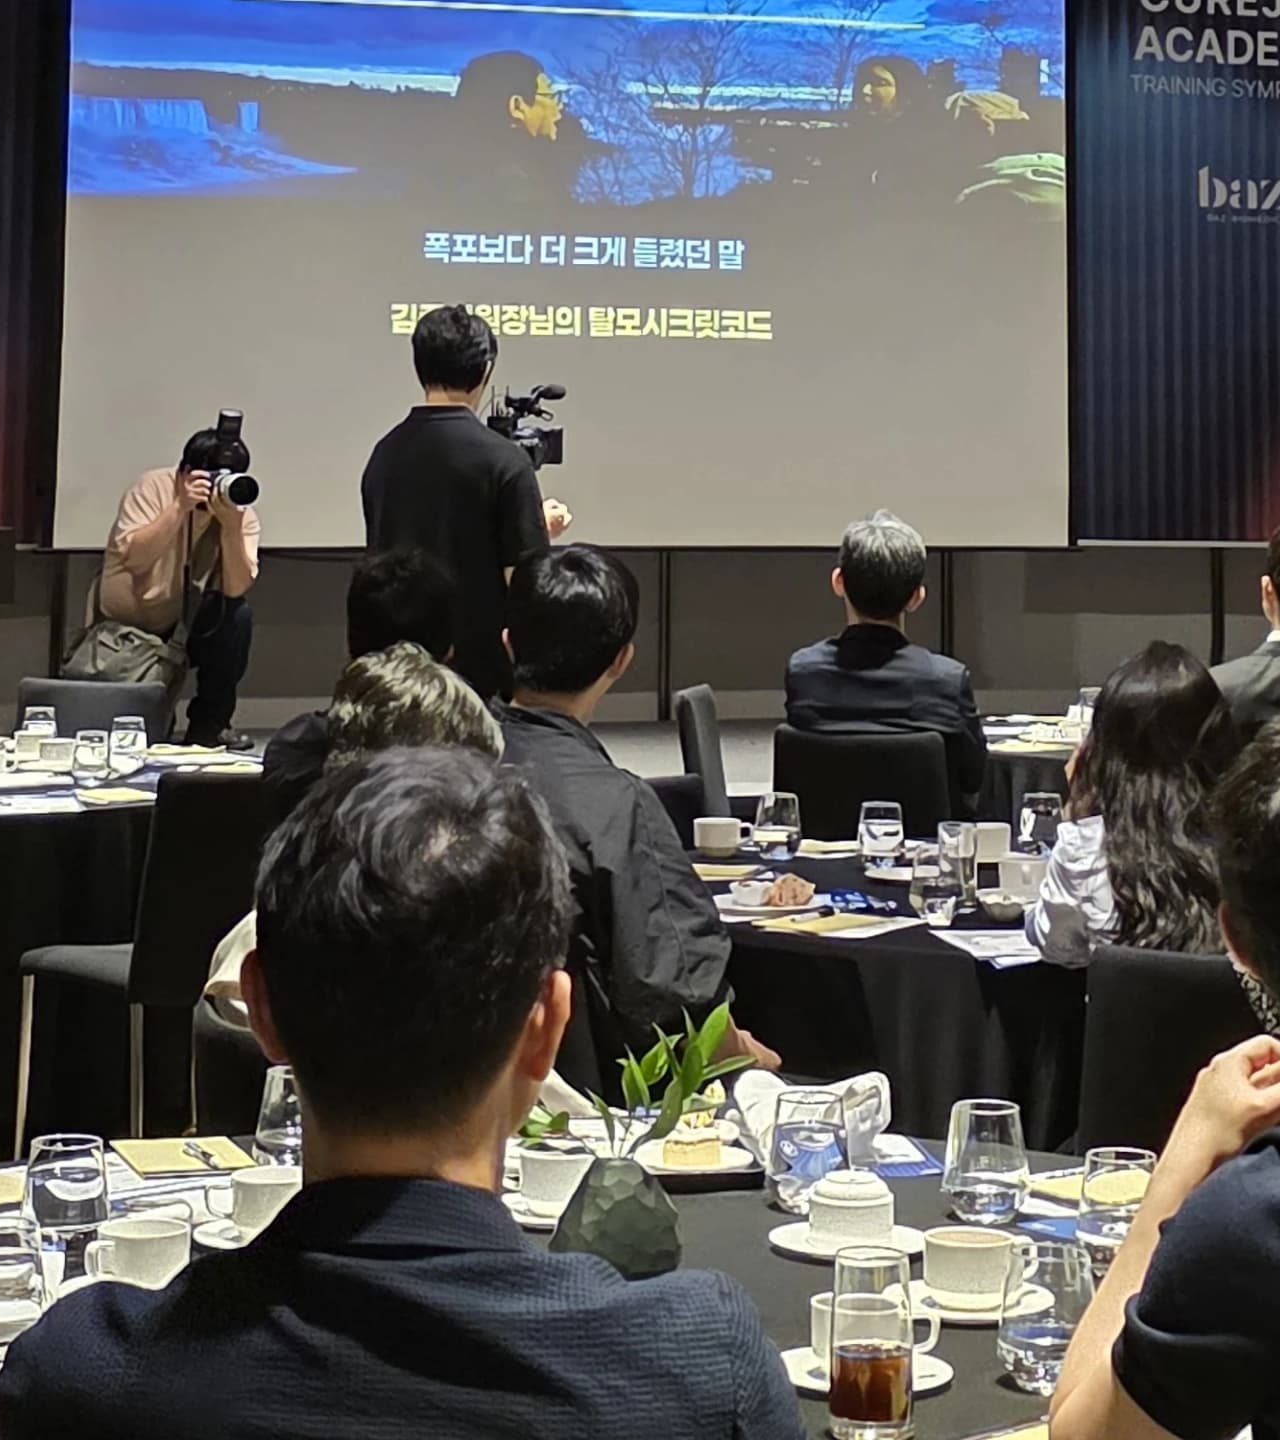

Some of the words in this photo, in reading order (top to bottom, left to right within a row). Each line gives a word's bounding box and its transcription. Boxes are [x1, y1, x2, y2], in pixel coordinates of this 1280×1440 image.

[1130, 74, 1226, 98] TRAINING
[423, 232, 533, 264] 폭포보다
[540, 235, 567, 266] 더
[572, 236, 627, 267] 크게
[633, 237, 712, 270] 들렸던
[717, 239, 745, 271] 말
[390, 303, 582, 337] 김원장님의
[588, 306, 774, 341] 탈모시크릿코드
